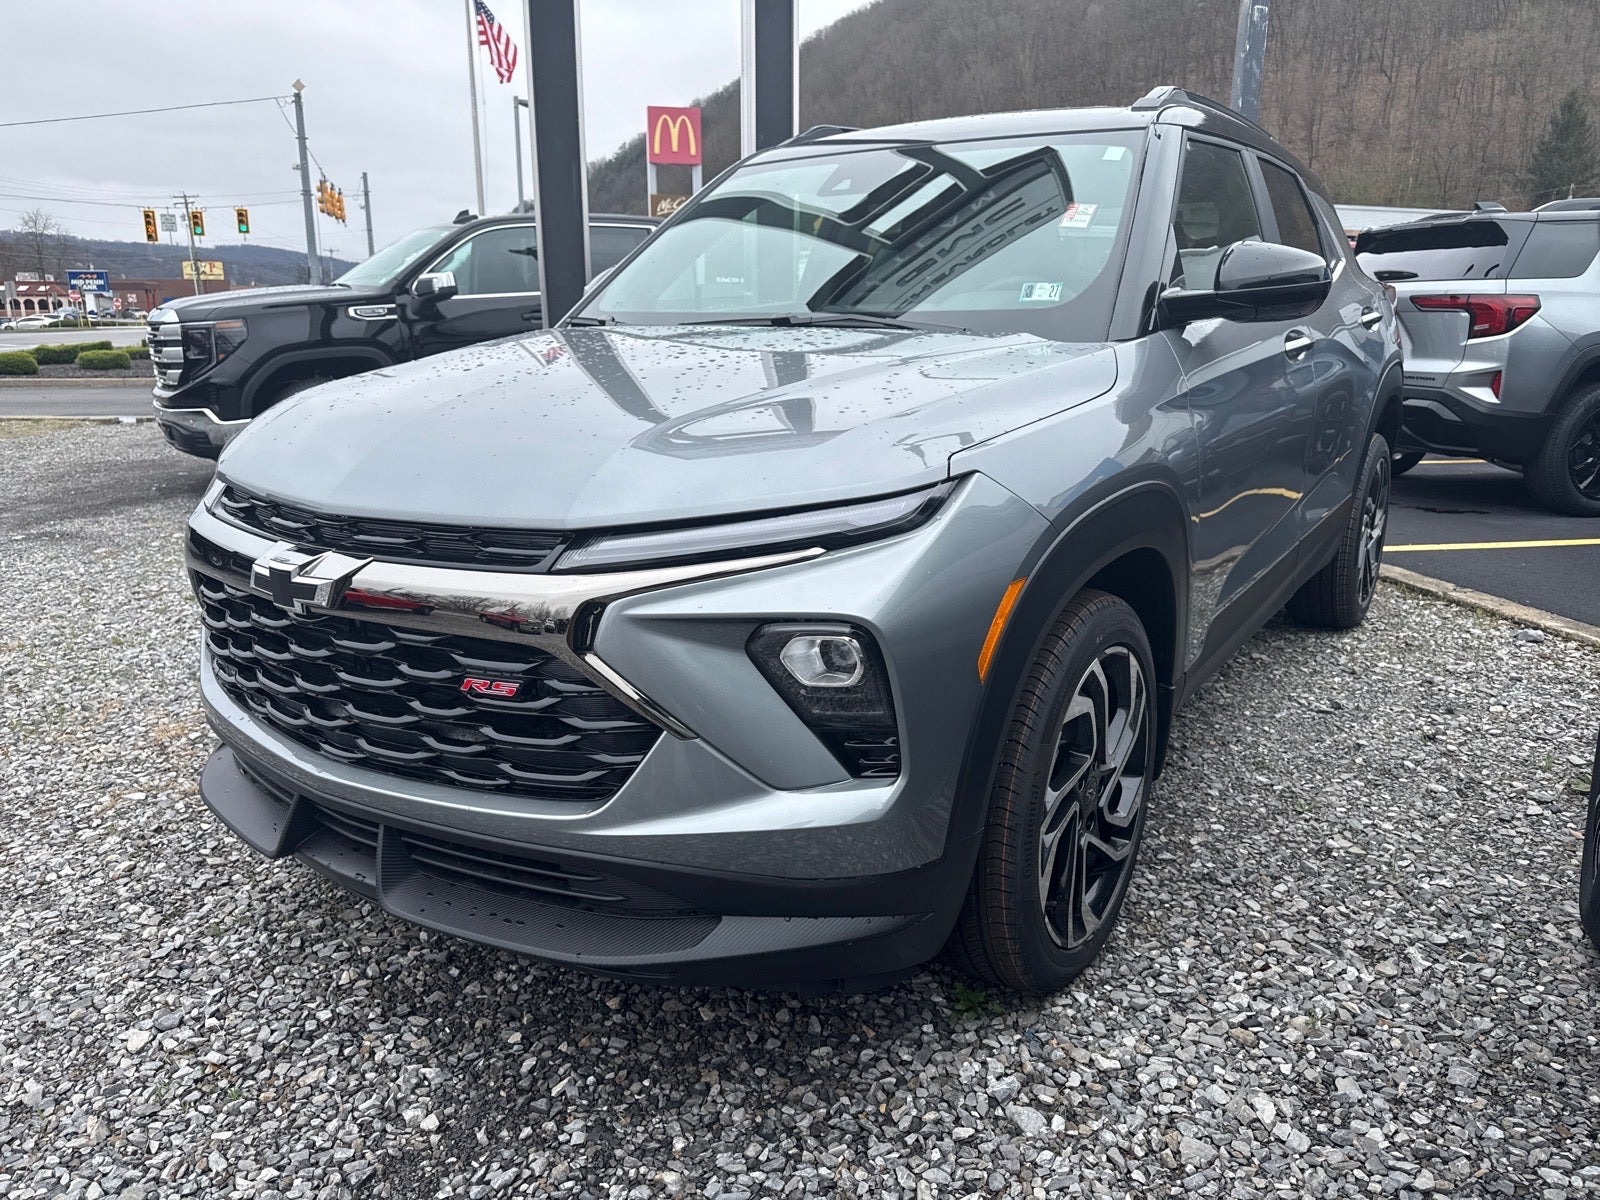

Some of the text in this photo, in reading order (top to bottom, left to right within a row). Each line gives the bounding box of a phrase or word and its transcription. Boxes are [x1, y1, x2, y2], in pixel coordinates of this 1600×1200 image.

[1025, 284, 1034, 298] 3
[1048, 284, 1060, 298] 27
[460, 677, 520, 697] RS
